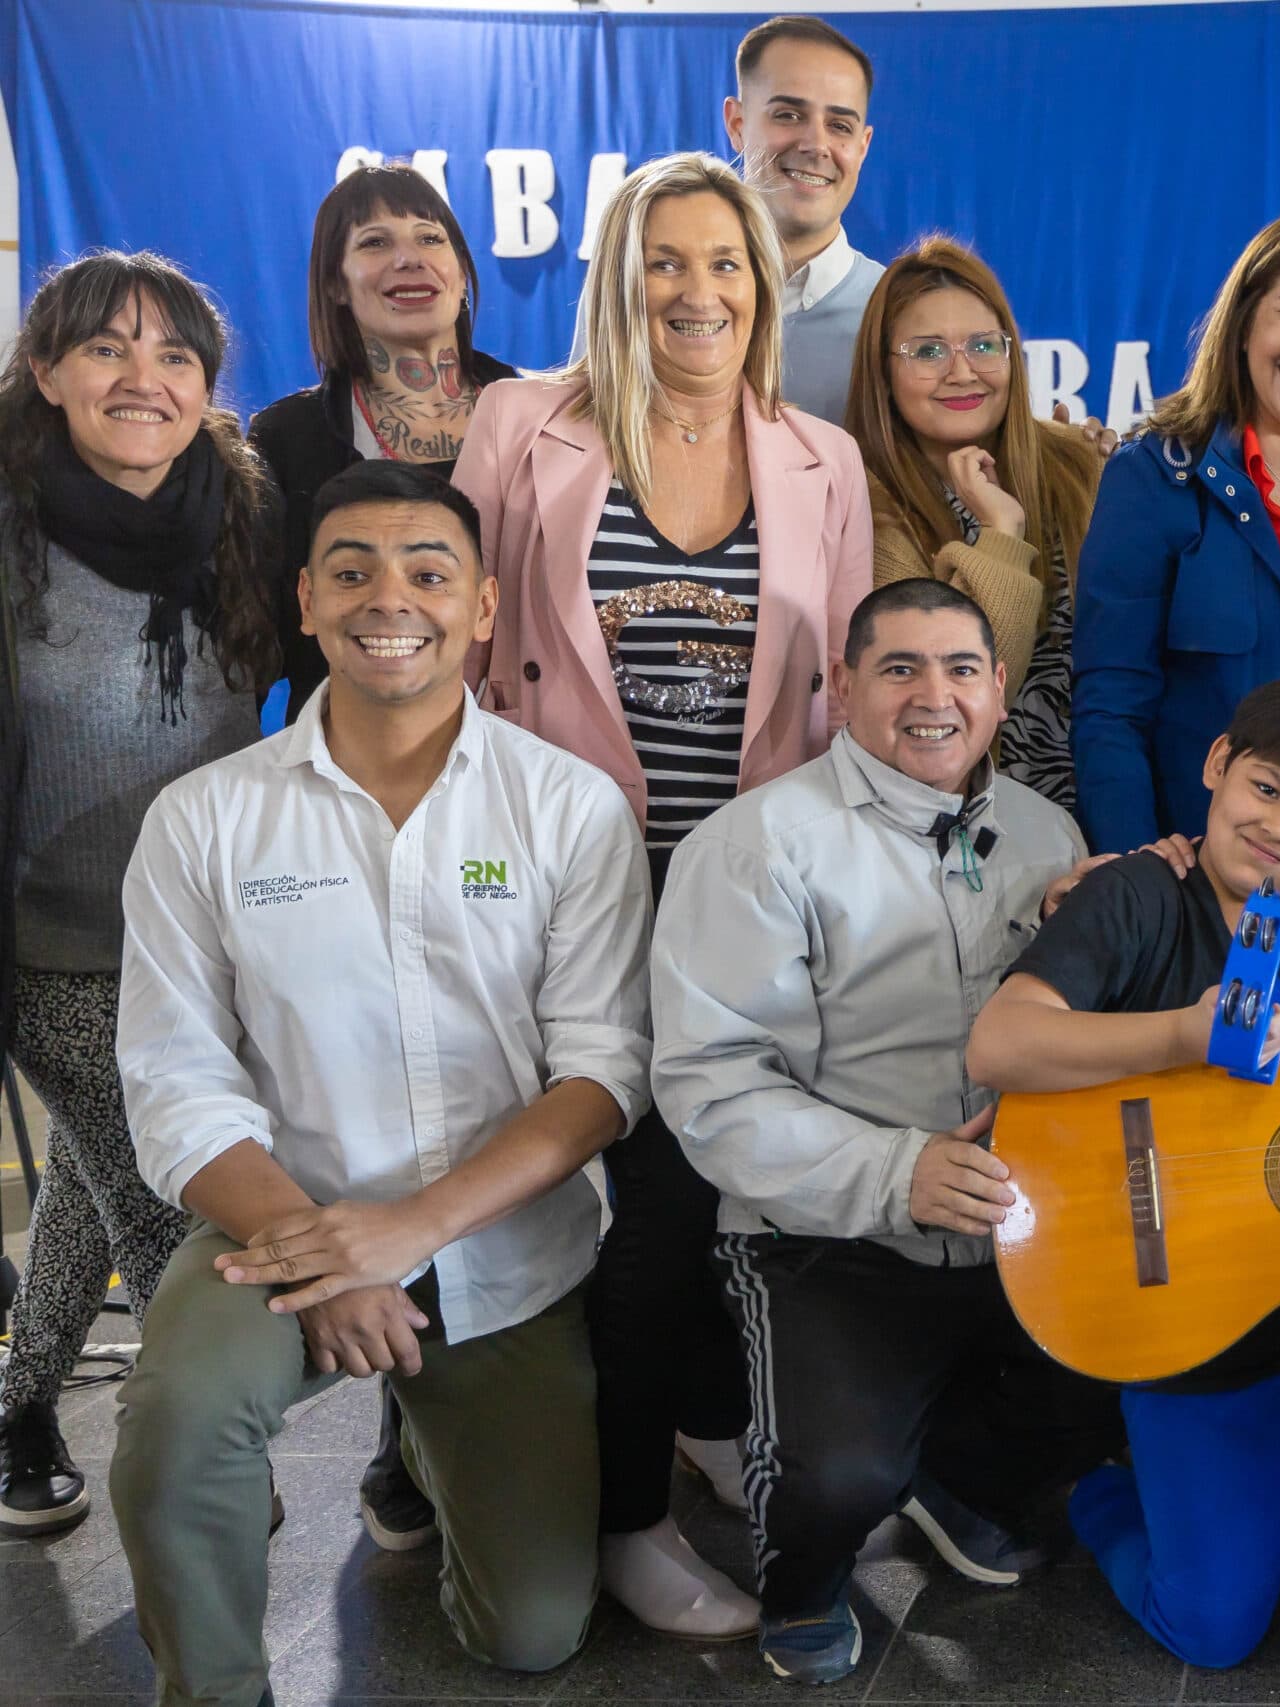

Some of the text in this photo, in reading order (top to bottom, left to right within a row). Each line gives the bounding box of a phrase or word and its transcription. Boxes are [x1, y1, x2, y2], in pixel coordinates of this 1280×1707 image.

[463, 859, 507, 885] RN
[243, 874, 297, 890] DIRECCIÓN
[244, 876, 349, 898] DE EDUCACIÓN FÍSICA
[461, 884, 508, 892] GOBIERNO
[246, 893, 303, 907] Y ARTÍSTICA
